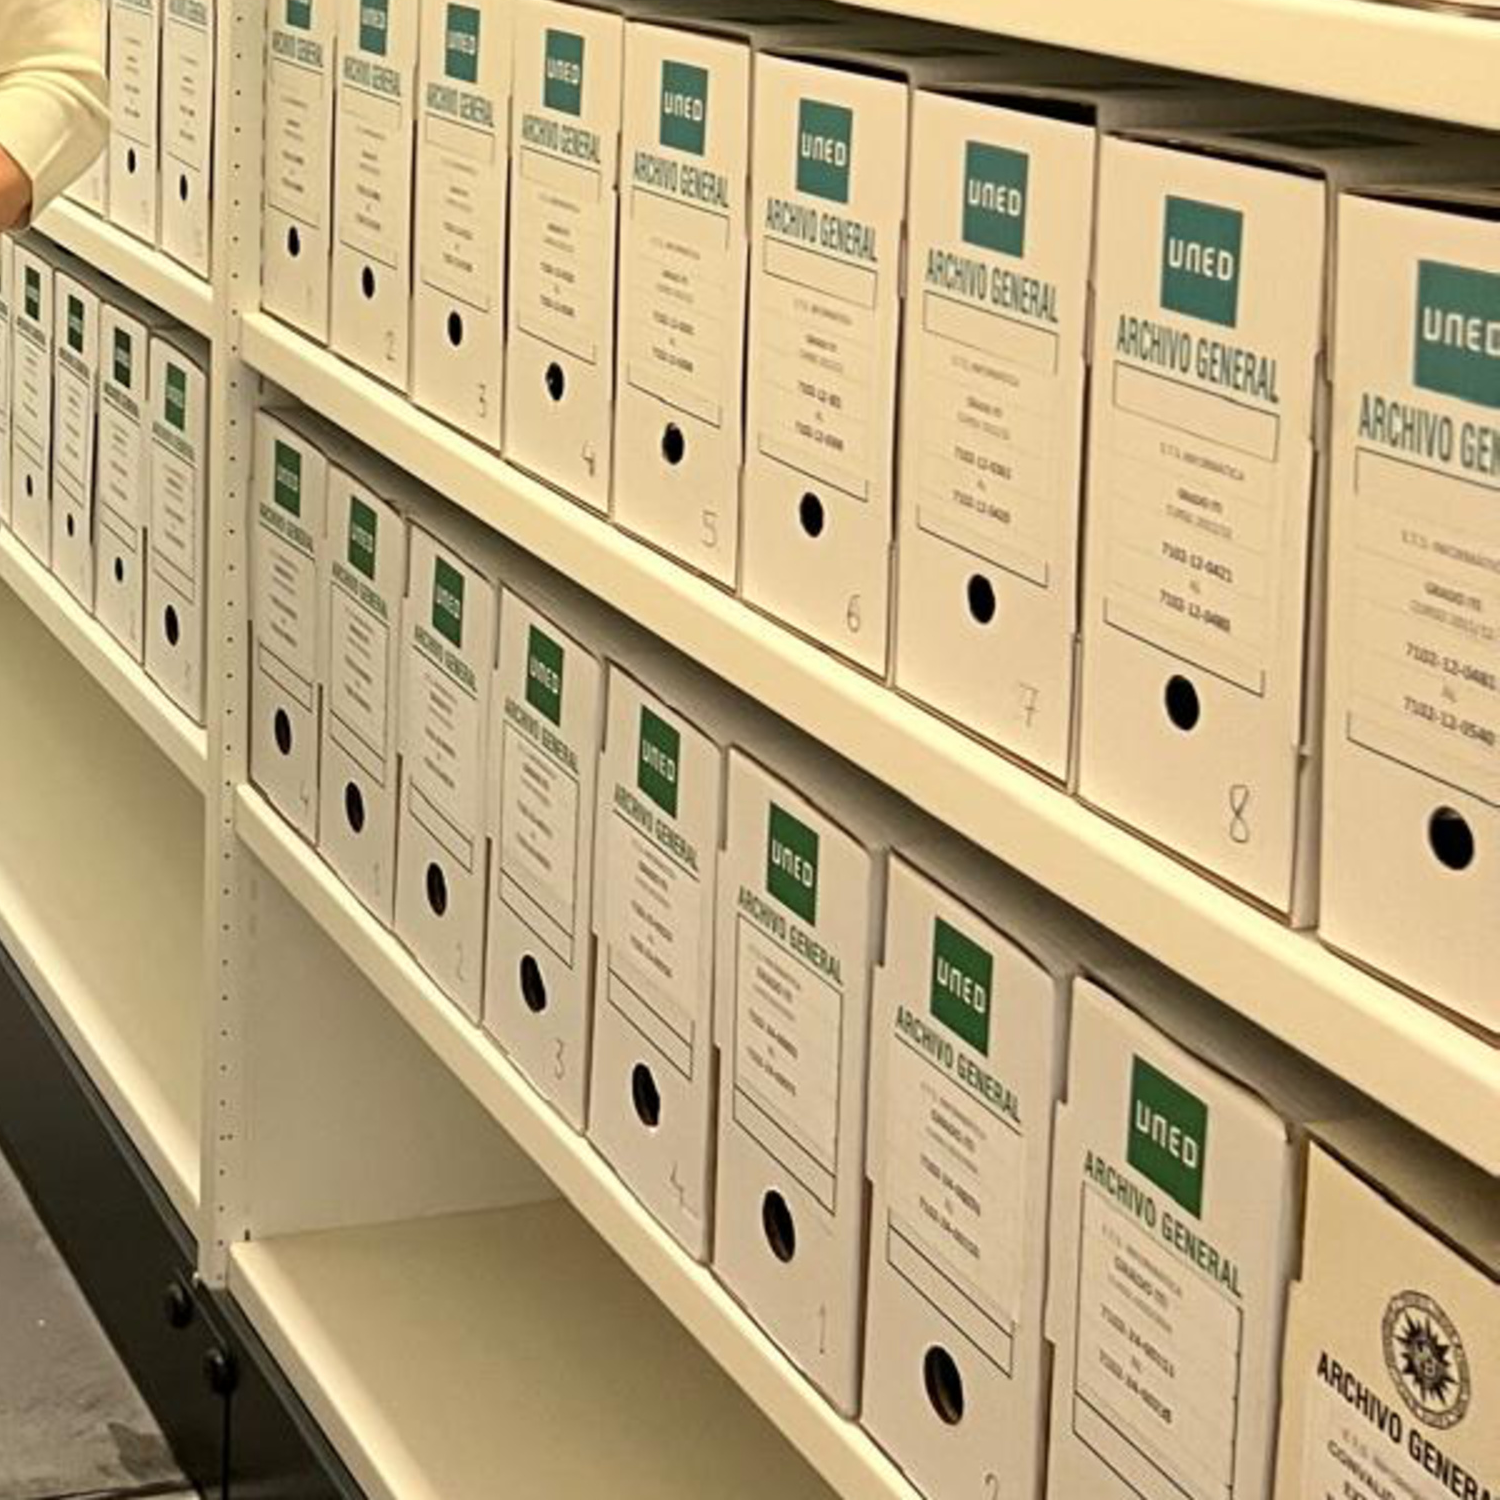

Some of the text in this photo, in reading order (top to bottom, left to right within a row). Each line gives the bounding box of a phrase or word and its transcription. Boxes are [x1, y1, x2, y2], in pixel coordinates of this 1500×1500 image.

[801, 132, 848, 168] UNED
[969, 178, 1022, 217] UNED
[766, 198, 878, 262] ARCHIVO GENERAL
[1169, 237, 1234, 282] UNED
[926, 248, 1059, 323] ARCHIVO GENERAL
[1116, 314, 1279, 403] ARCHIVO GENERAL
[1358, 392, 1500, 478] ARCHIVO GEN
[701, 509, 718, 549] 5
[846, 594, 862, 635] 6
[1228, 783, 1251, 845] 8
[771, 838, 816, 889] UNED
[936, 956, 987, 1015] UNED
[896, 1005, 1021, 1125] ARCHIVO GENERAL
[1135, 1099, 1199, 1169] UNED
[1083, 1150, 1243, 1300] ARCHIVO GENERAL
[1317, 1350, 1402, 1444] ARCHIVO
[1408, 1428, 1493, 1500] GENER
